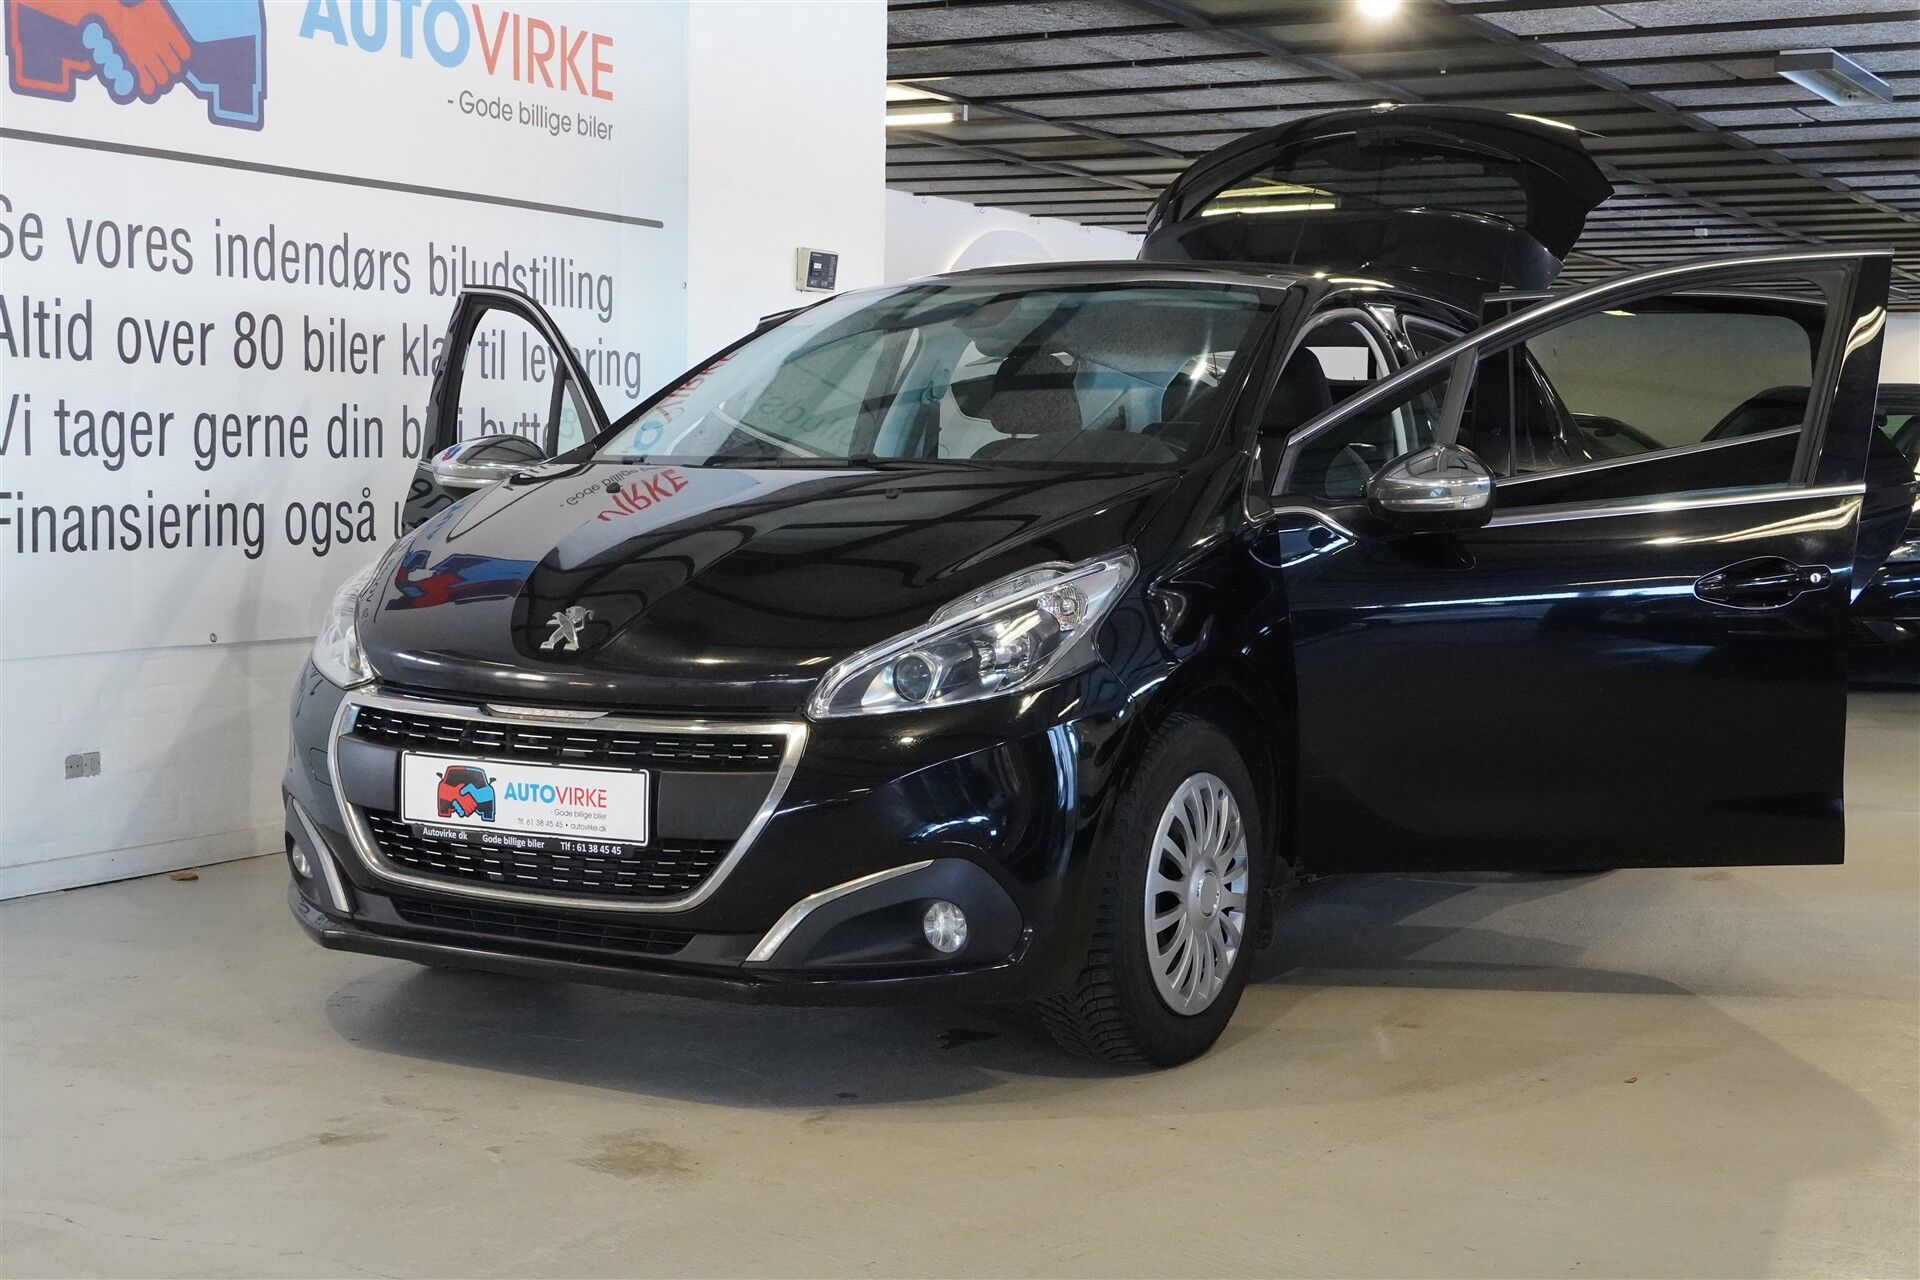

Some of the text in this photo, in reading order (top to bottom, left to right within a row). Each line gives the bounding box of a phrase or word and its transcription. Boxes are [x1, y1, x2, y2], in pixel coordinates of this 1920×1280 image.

[297, 0, 614, 101] AUTOVIRKE
[459, 90, 513, 121] Gode
[519, 101, 572, 136] billige
[577, 113, 614, 140] biler
[66, 217, 194, 275] vores
[215, 218, 412, 295] indendørs
[429, 241, 613, 324] biludstilling
[117, 316, 215, 366] over
[233, 310, 284, 370] 80
[303, 314, 385, 375] biler
[402, 322, 446, 377] kla
[477, 328, 506, 380] til
[53, 398, 175, 472] tager
[194, 411, 308, 471] gerne
[326, 402, 384, 459] din
[285, 486, 377, 557] også
[503, 781, 607, 809] AUTOVIRKE
[554, 808, 573, 817] Gode
[482, 834, 502, 844] Gode
[503, 836, 526, 848] billige
[527, 838, 545, 849] biler
[576, 843, 587, 853] 61
[588, 844, 599, 853] 38
[600, 845, 610, 854] 45
[611, 846, 622, 855] 45
